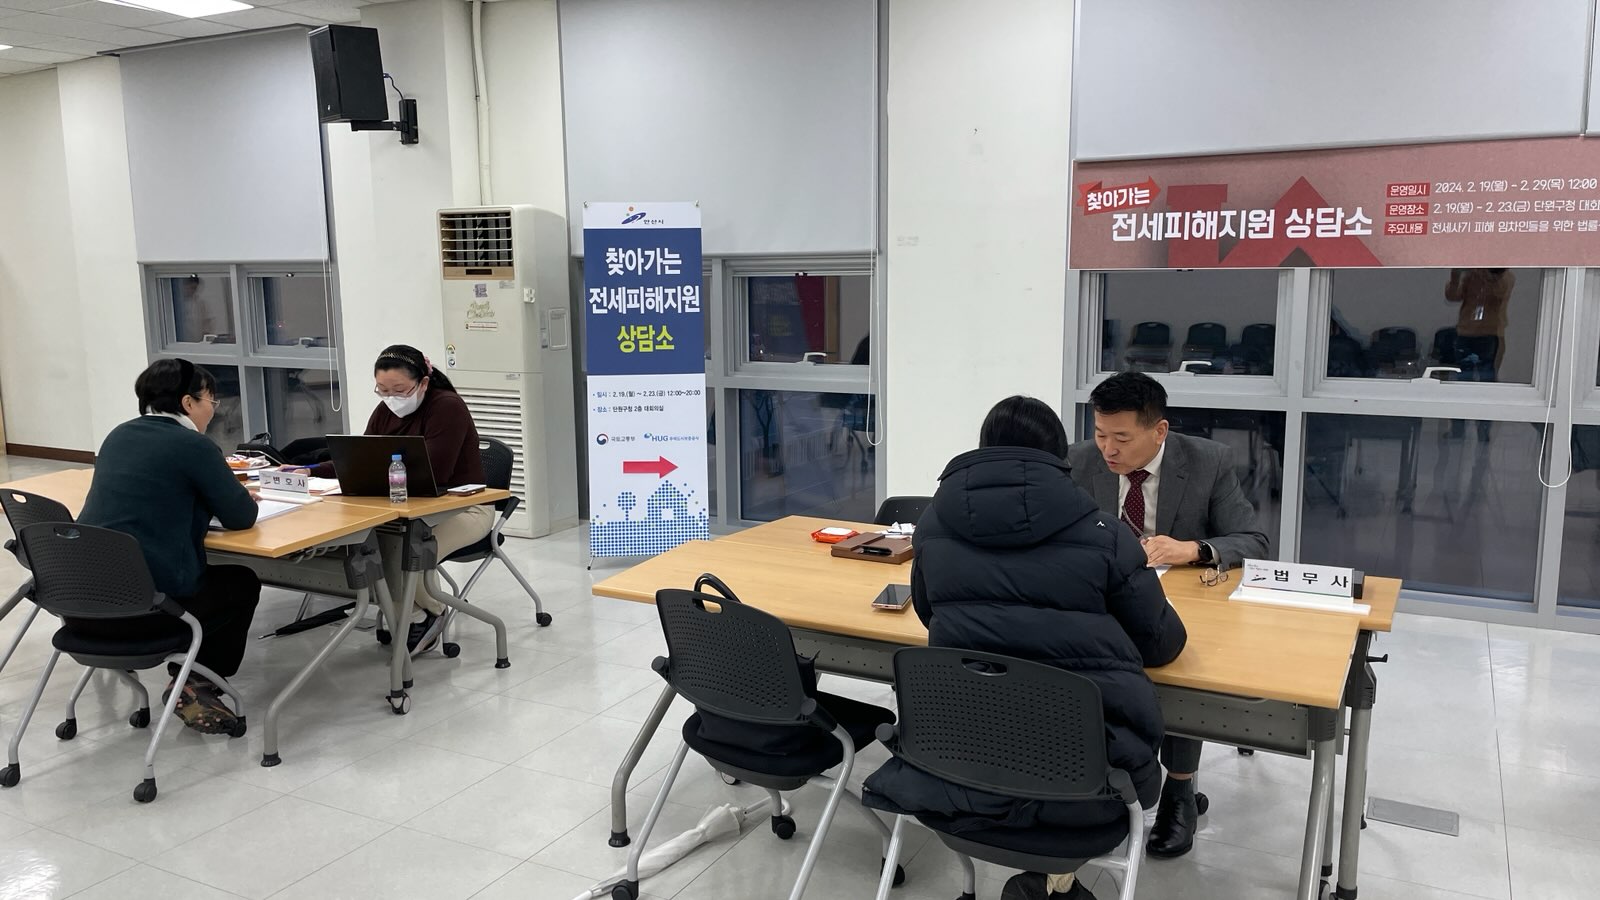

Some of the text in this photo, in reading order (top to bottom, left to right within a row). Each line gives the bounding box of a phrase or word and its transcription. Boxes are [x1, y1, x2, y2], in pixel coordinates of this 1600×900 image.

[1087, 187, 1150, 211] 찾아가는
[1390, 184, 1427, 197] 운영일시
[1434, 182, 1464, 193] 2024.
[1479, 180, 1508, 192] 19.(월)
[1532, 178, 1565, 191] 29.(목)
[1567, 178, 1598, 189] 12:00
[1389, 204, 1425, 216] 운영장소
[1445, 201, 1474, 214] 19.(월)
[1497, 200, 1531, 213] 23.(금)
[1534, 199, 1576, 212] 단원구청
[1112, 206, 1373, 242] 전세피해지원 상담소
[1387, 223, 1423, 234] 주요내용
[1432, 221, 1471, 234] 전세사기
[1474, 220, 1495, 233] 피해
[1498, 220, 1549, 233] 임차인들을
[1552, 219, 1575, 232] 위한
[605, 247, 682, 276] 찾아가는
[588, 284, 701, 315] 전세피해지원
[616, 324, 675, 354] 상담소
[1274, 569, 1349, 588] 법무사
